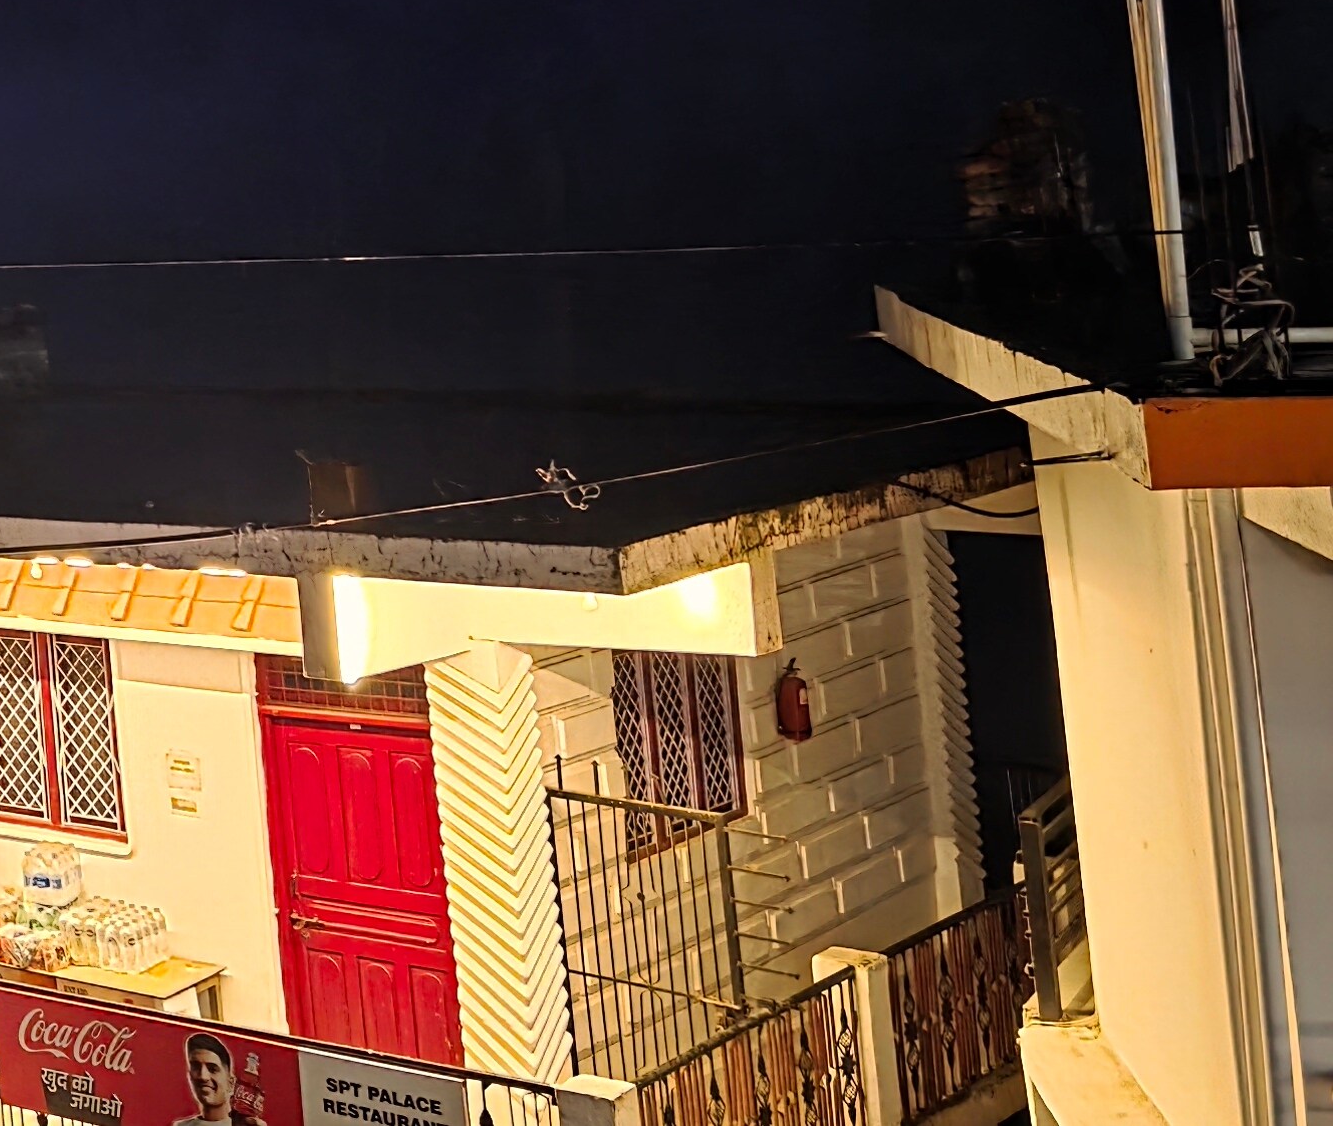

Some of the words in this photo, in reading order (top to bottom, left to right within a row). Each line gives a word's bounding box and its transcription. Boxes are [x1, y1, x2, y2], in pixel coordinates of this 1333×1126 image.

[18, 1008, 136, 1074] Coca-Cola
[41, 1067, 68, 1091] खुद
[72, 1071, 94, 1094] को
[326, 1077, 362, 1098] SPT
[368, 1086, 443, 1116] PALACE
[70, 1093, 122, 1118] जगाओ
